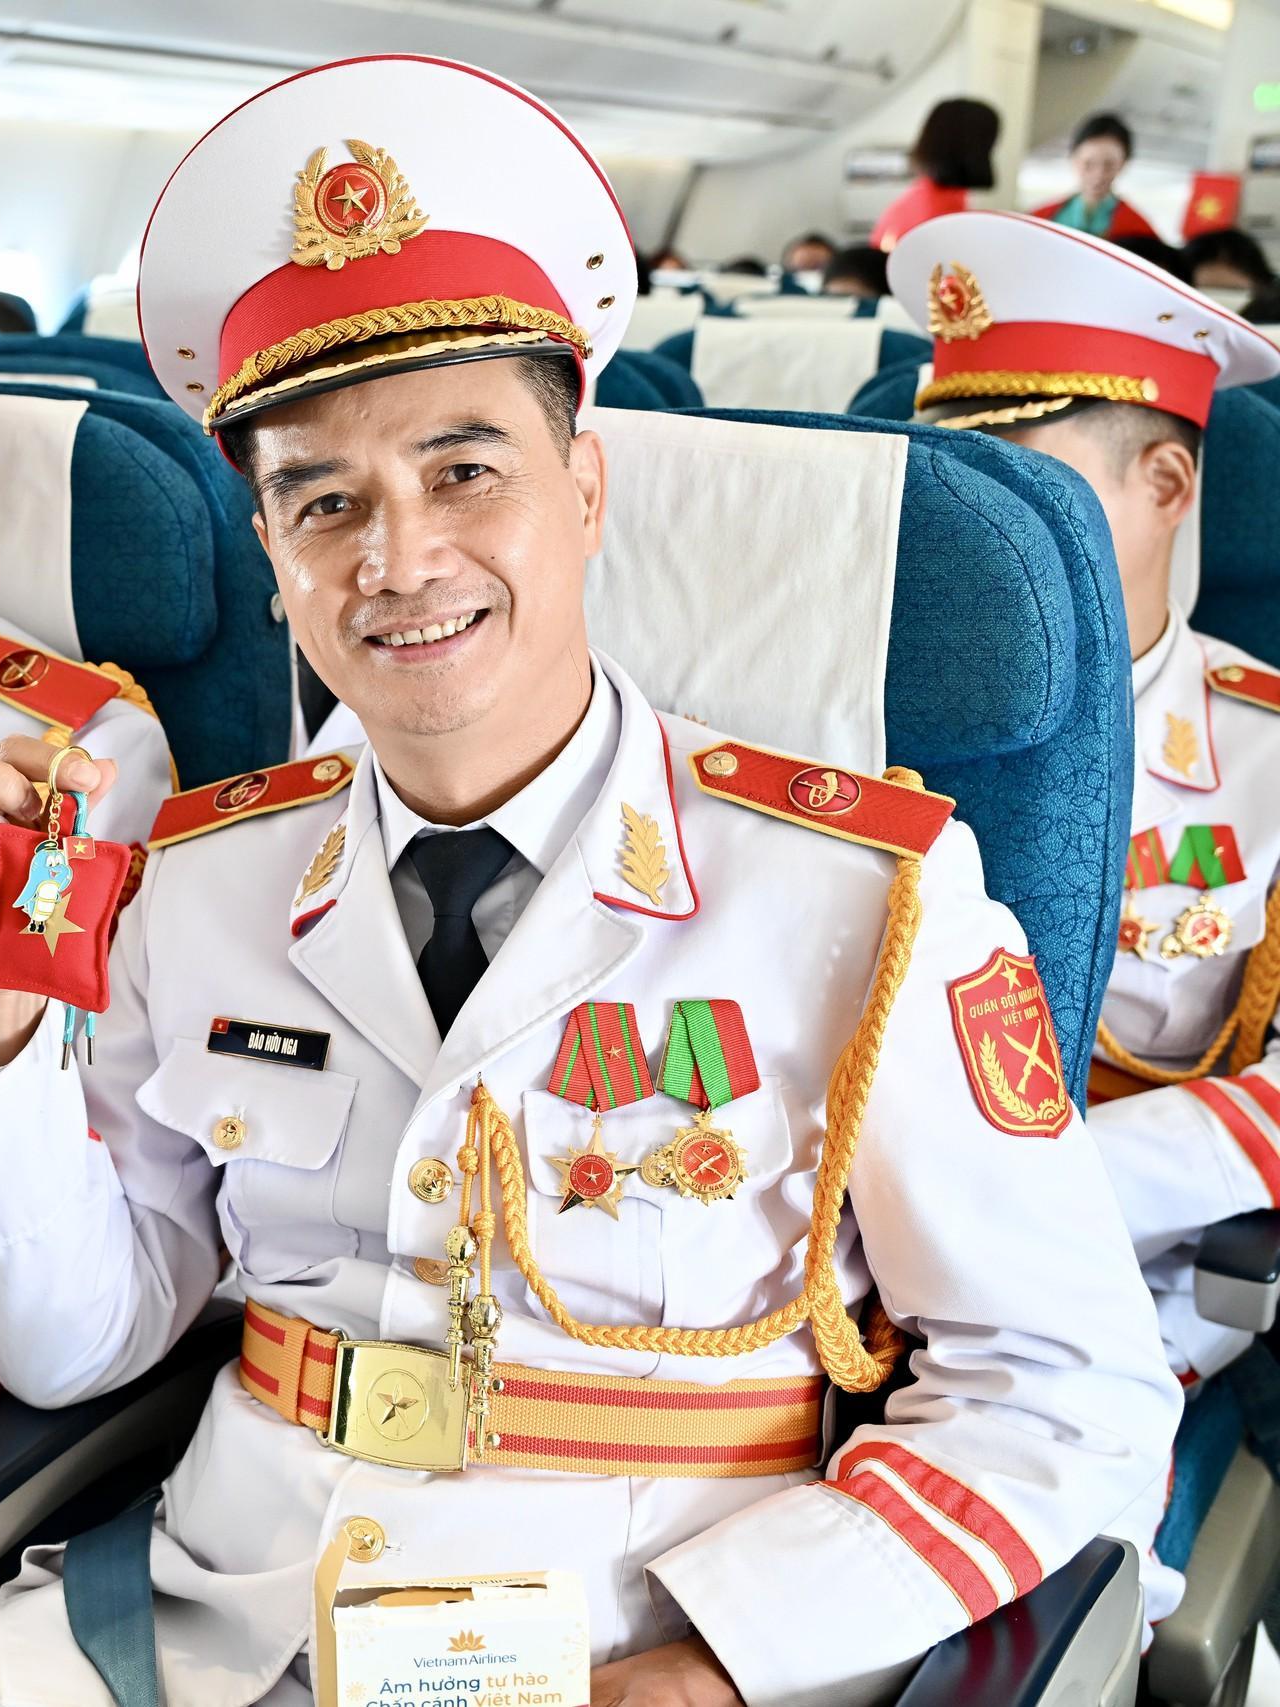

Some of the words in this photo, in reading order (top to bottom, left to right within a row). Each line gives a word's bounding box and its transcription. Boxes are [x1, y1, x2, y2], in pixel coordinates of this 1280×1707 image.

[970, 999, 999, 1018] QUÂN
[1001, 992, 1018, 1008] ĐỘI
[1001, 1010, 1022, 1027] VIỆT
[281, 1038, 298, 1055] NGA
[413, 1655, 467, 1668] Vietnam
[469, 1653, 517, 1665] Airlines
[380, 1678, 412, 1694] Âm
[419, 1675, 481, 1692] hưởng
[487, 1675, 508, 1690] tự
[513, 1672, 548, 1687] hào
[517, 1691, 562, 1705] Nam
